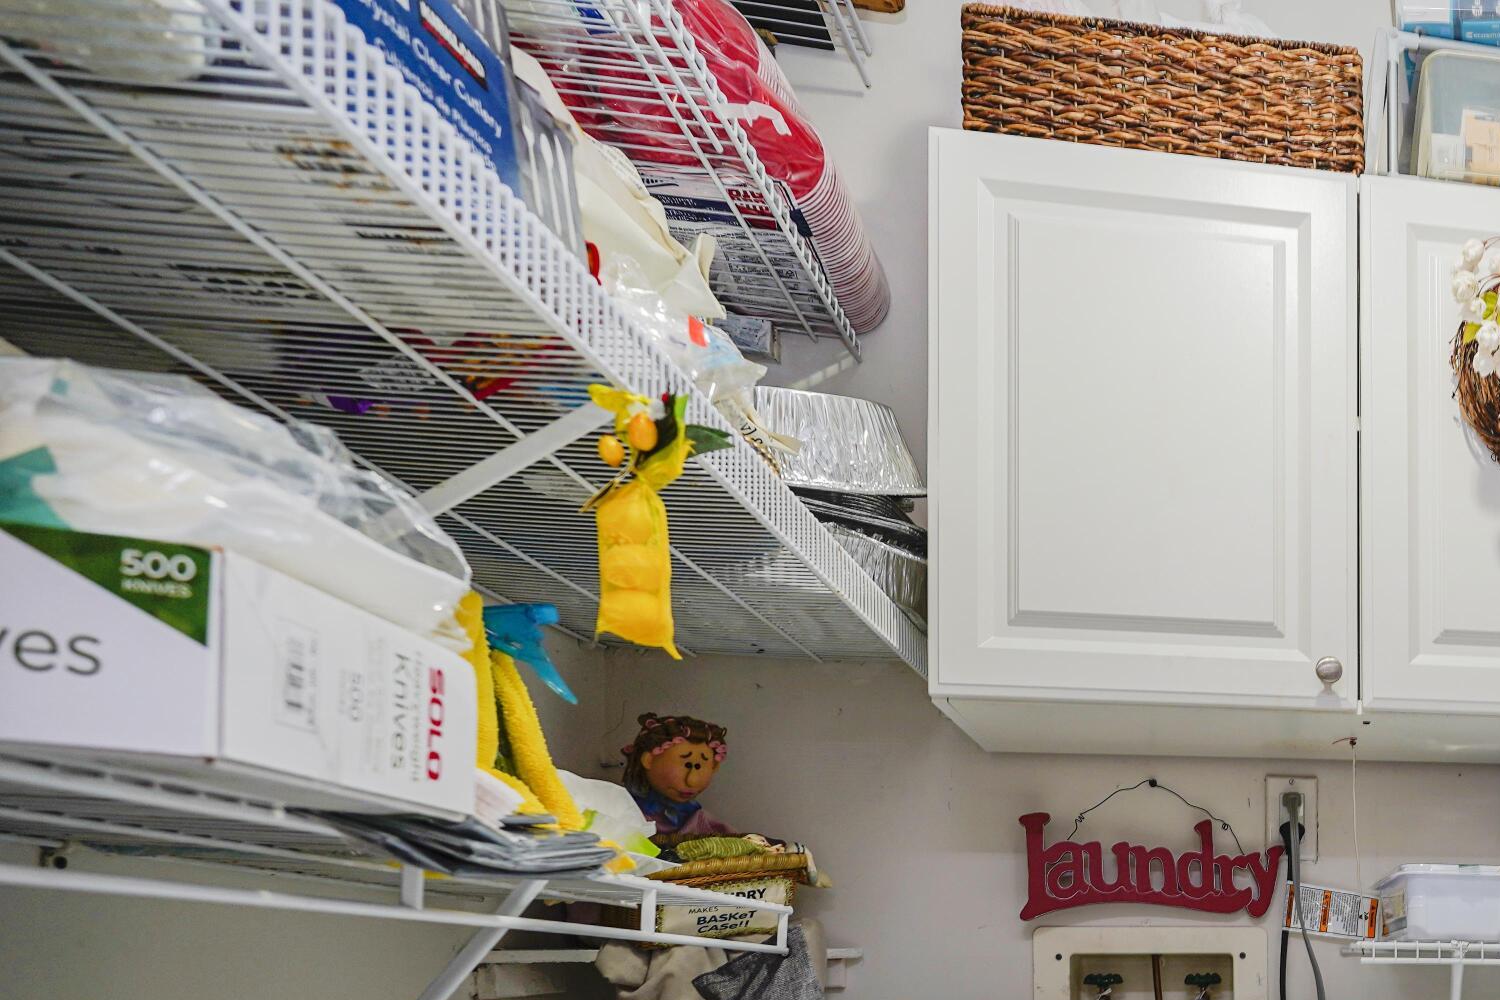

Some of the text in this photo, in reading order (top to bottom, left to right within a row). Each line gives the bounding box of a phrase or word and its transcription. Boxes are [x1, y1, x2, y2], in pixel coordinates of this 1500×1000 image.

[119, 548, 197, 579] 500
[120, 577, 194, 599] KNIVES
[391, 652, 411, 770] Knives
[426, 668, 446, 782] SOLO
[1018, 812, 1287, 922] laundry
[688, 905, 720, 915] MAKES
